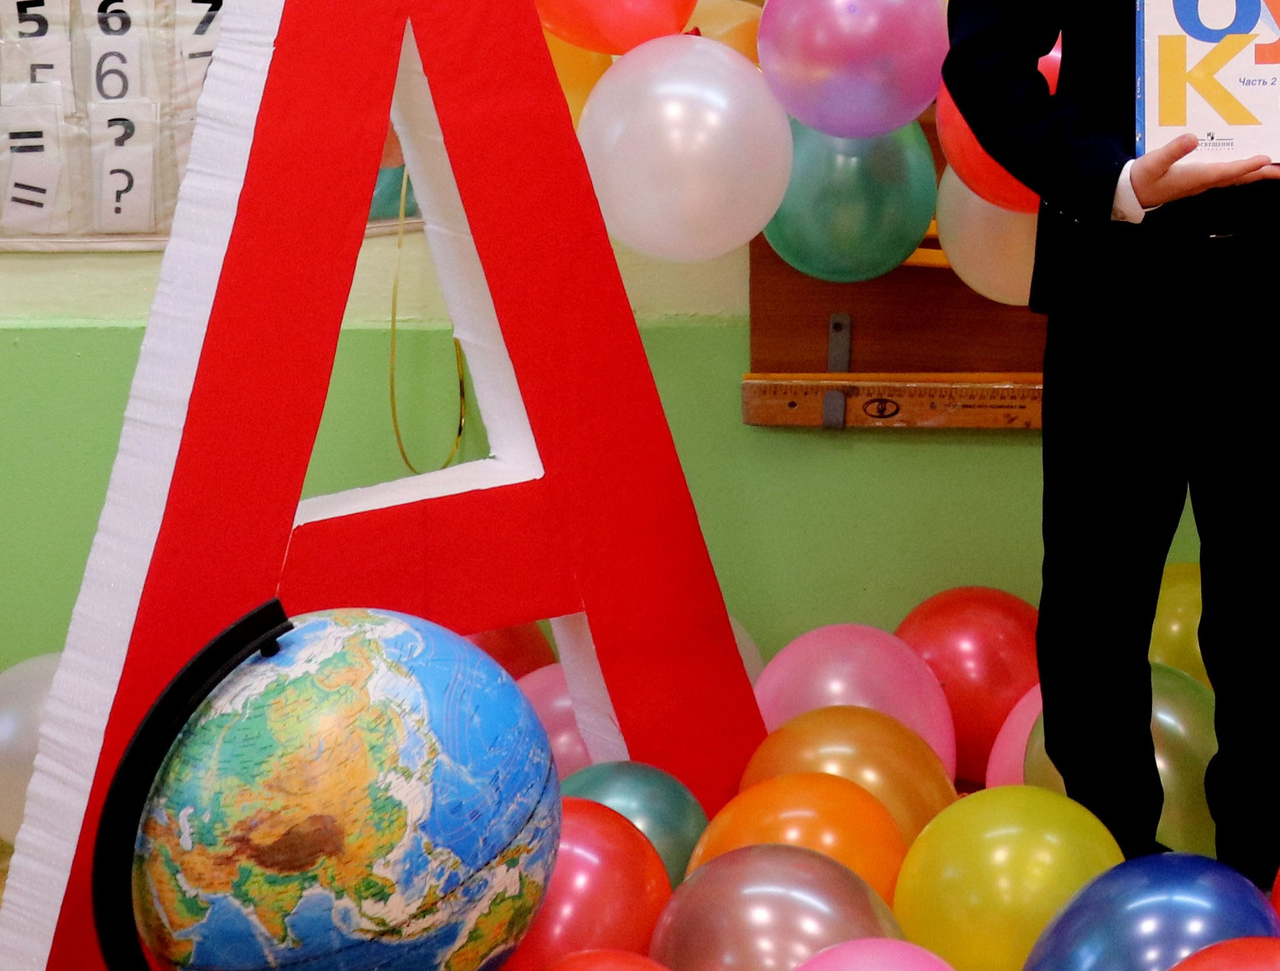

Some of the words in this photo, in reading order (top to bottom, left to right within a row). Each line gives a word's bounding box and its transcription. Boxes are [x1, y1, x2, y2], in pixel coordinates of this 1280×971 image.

[95, 51, 129, 100] 6
[1238, 77, 1268, 86] Часть
[1270, 77, 1278, 86] 2
[109, 168, 134, 214] ?
